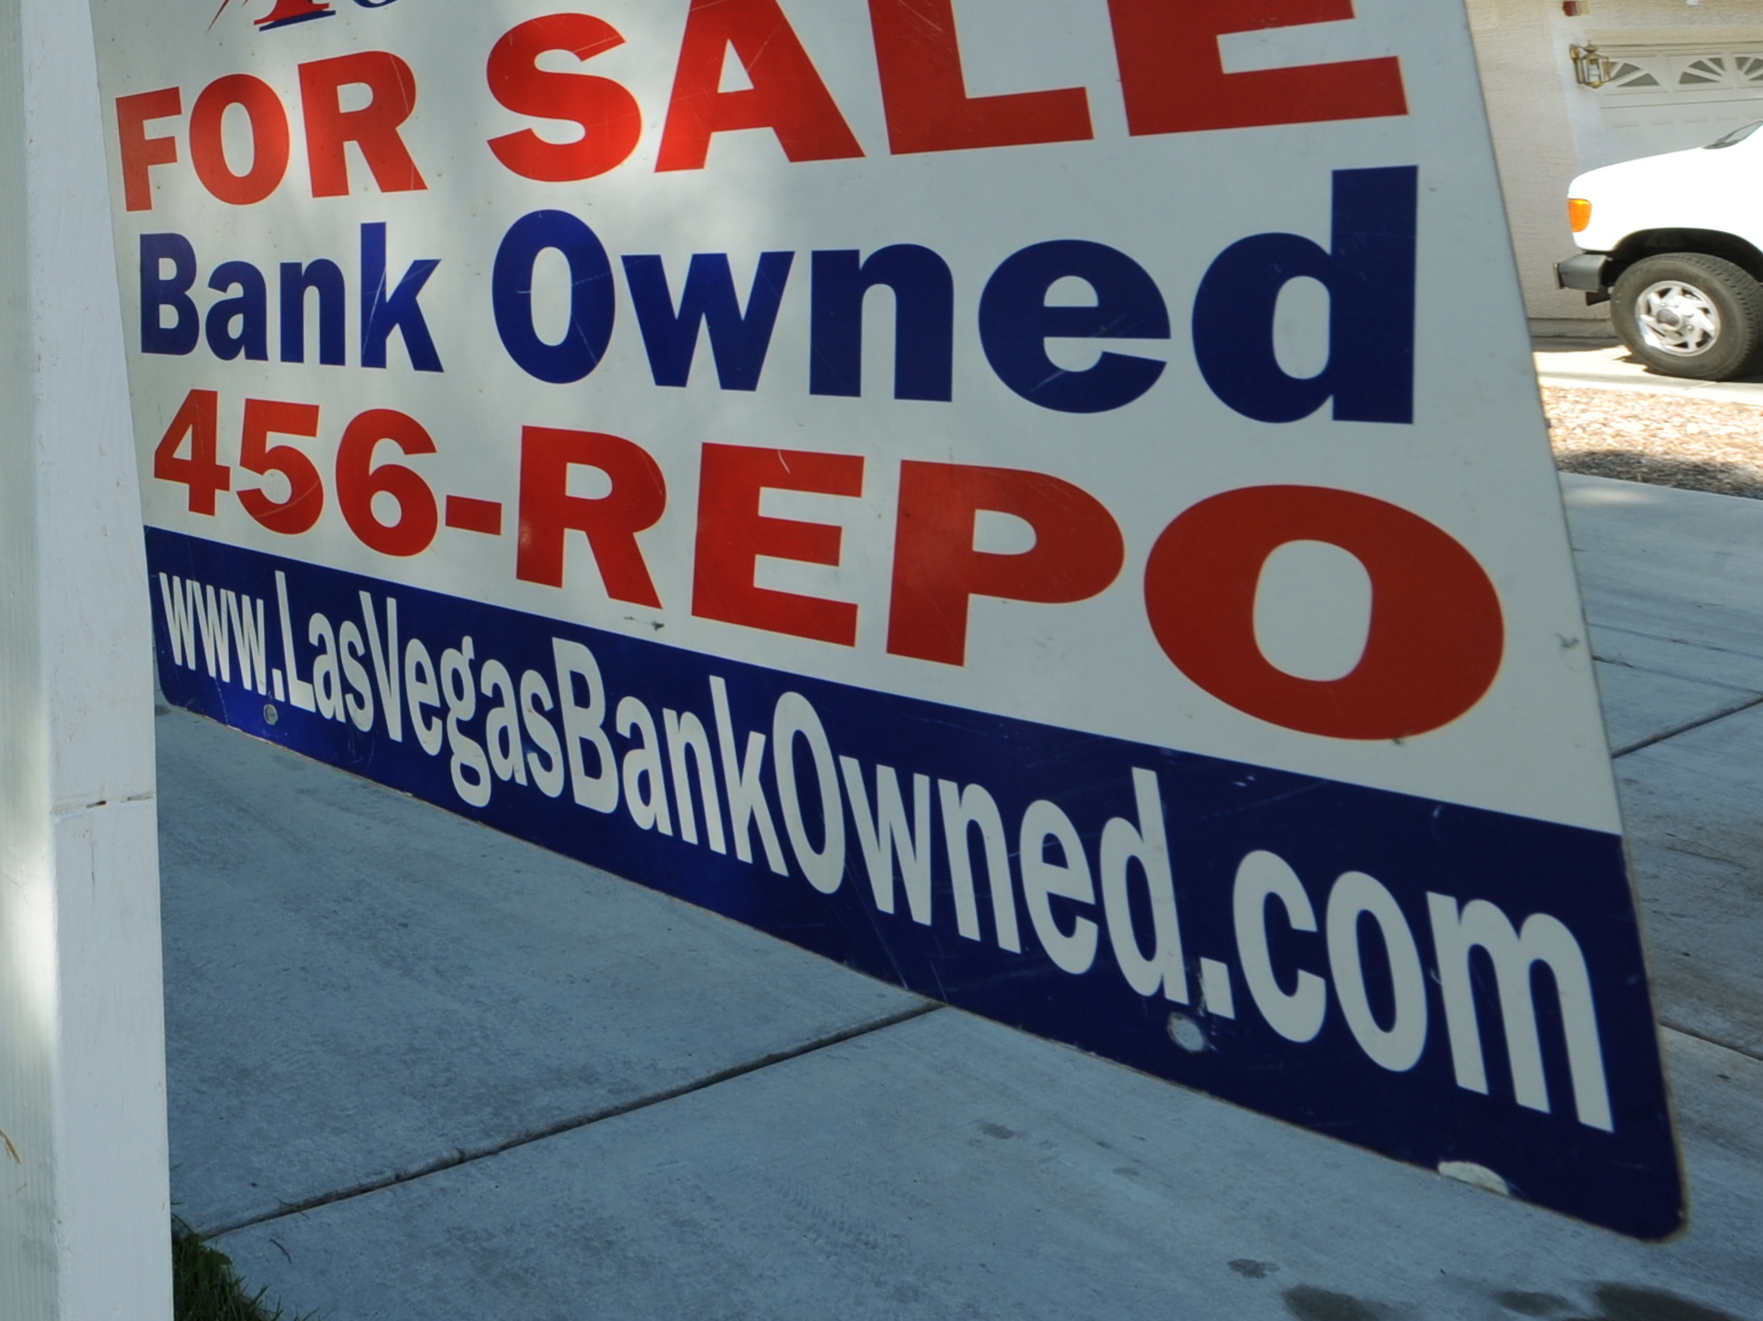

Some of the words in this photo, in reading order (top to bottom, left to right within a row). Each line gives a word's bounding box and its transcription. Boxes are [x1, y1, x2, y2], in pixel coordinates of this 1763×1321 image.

[116, 50, 428, 211] FOR
[139, 222, 444, 373] Bank
[491, 165, 1418, 424] Owned
[153, 389, 1504, 741] 456-REPO
[160, 570, 1614, 1133] www.LasVegasBankOwned.com
